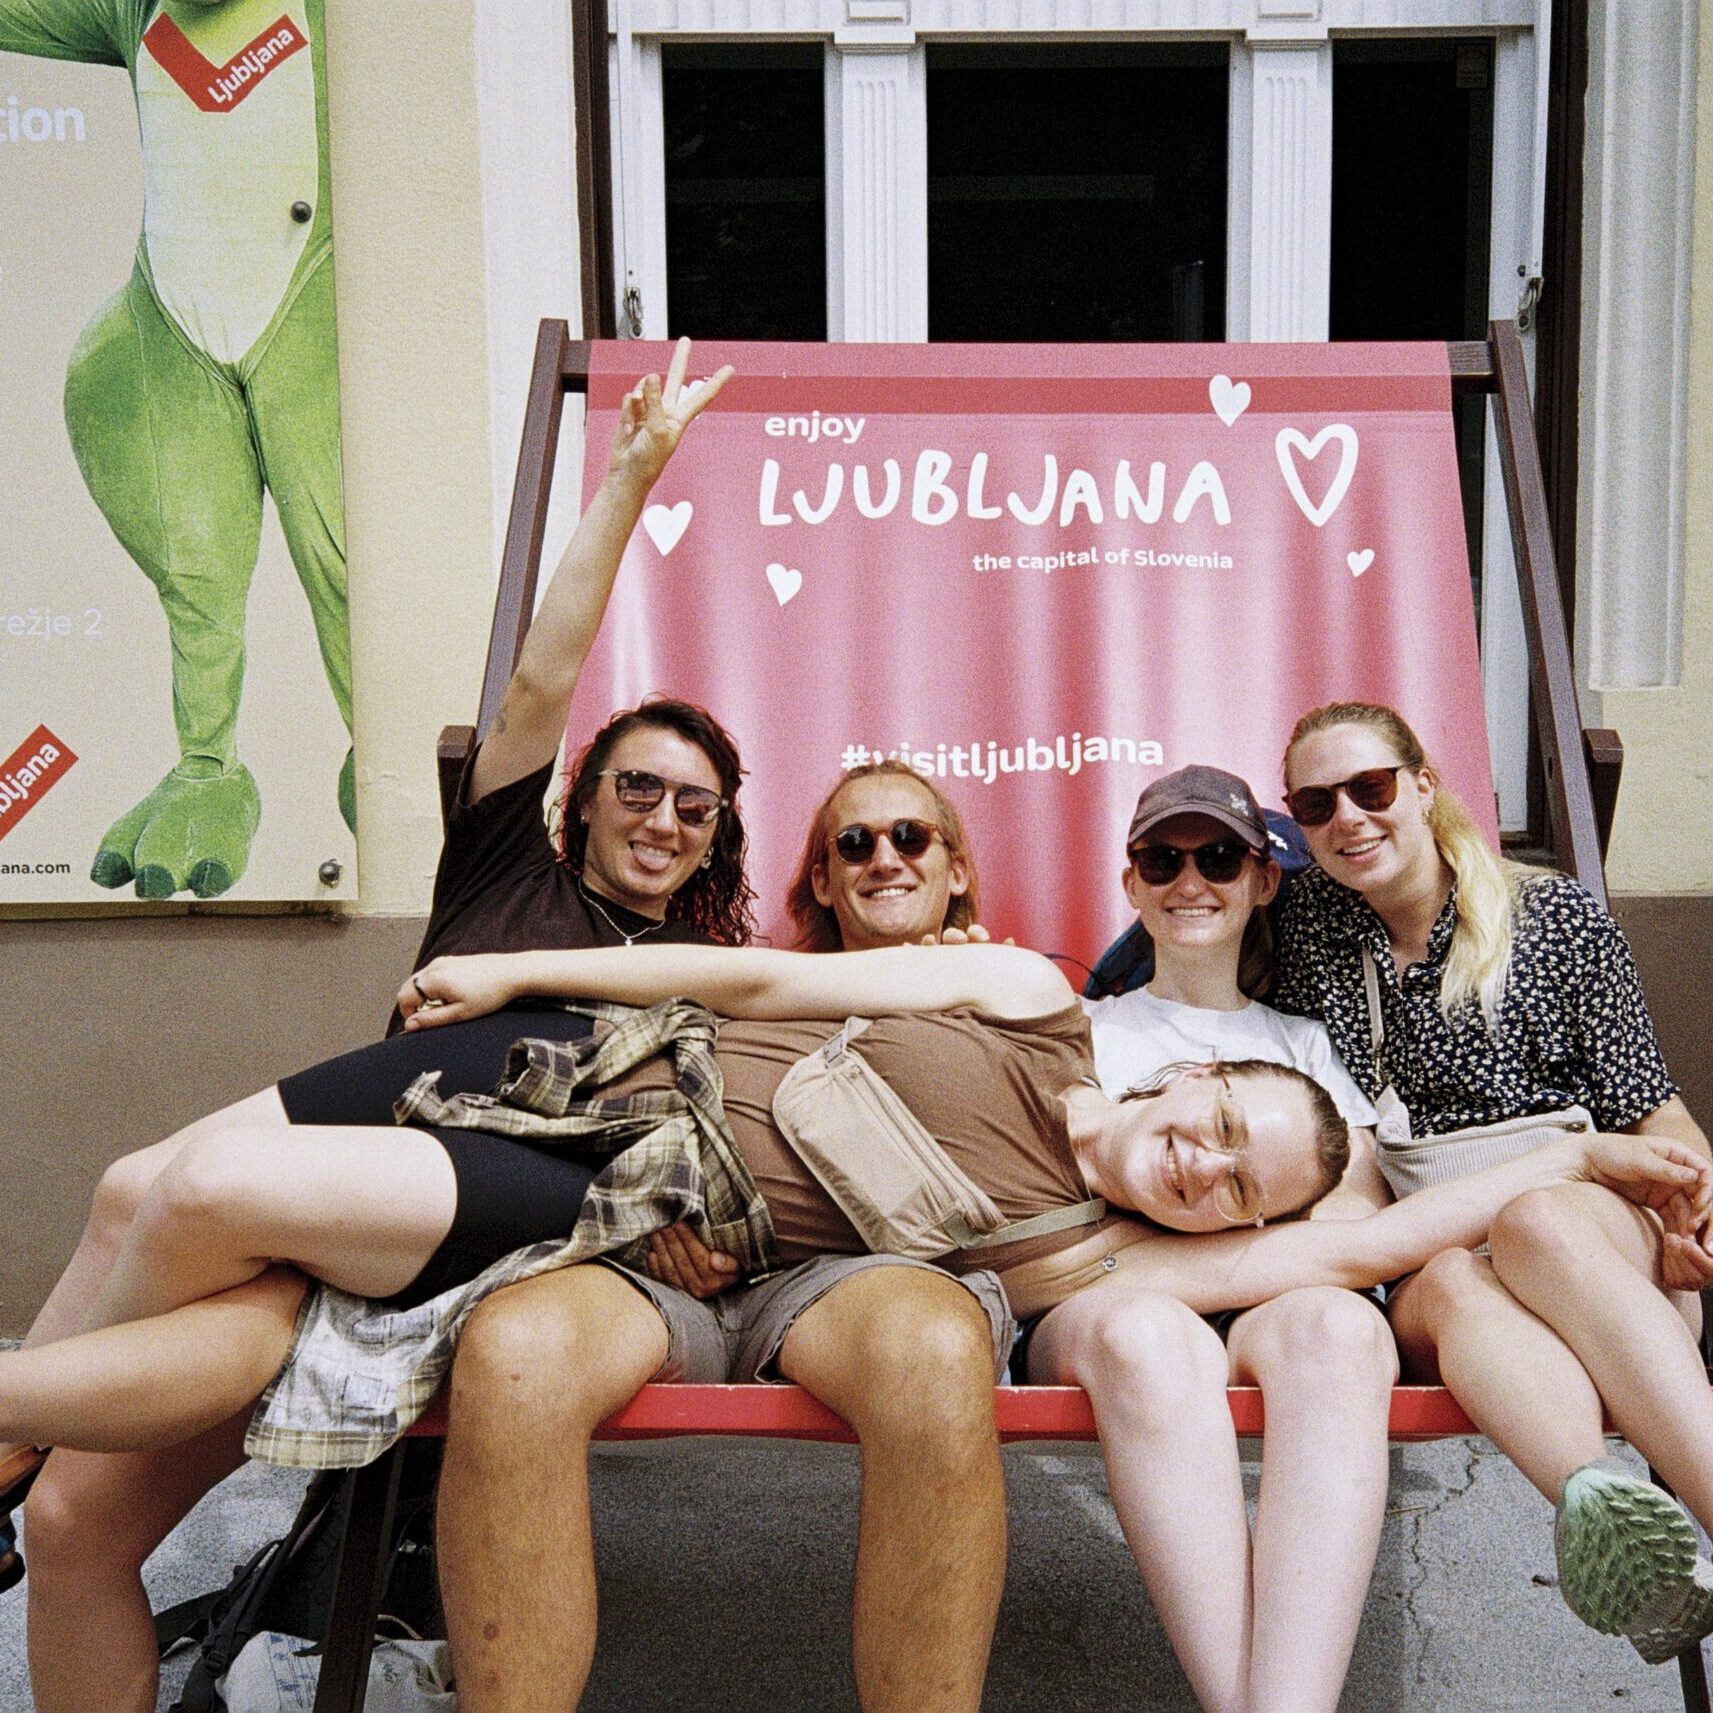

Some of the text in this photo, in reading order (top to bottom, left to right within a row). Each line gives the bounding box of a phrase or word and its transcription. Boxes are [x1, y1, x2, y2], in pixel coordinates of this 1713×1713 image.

[207, 27, 295, 104] Ljubljana
[763, 410, 866, 445] enjoy
[758, 448, 1233, 528] LJUBLJANA
[972, 547, 1234, 575] the capital of Slovenia
[84, 607, 104, 636] 2
[0, 743, 61, 818] bljana
[0, 863, 71, 875] ana.com
